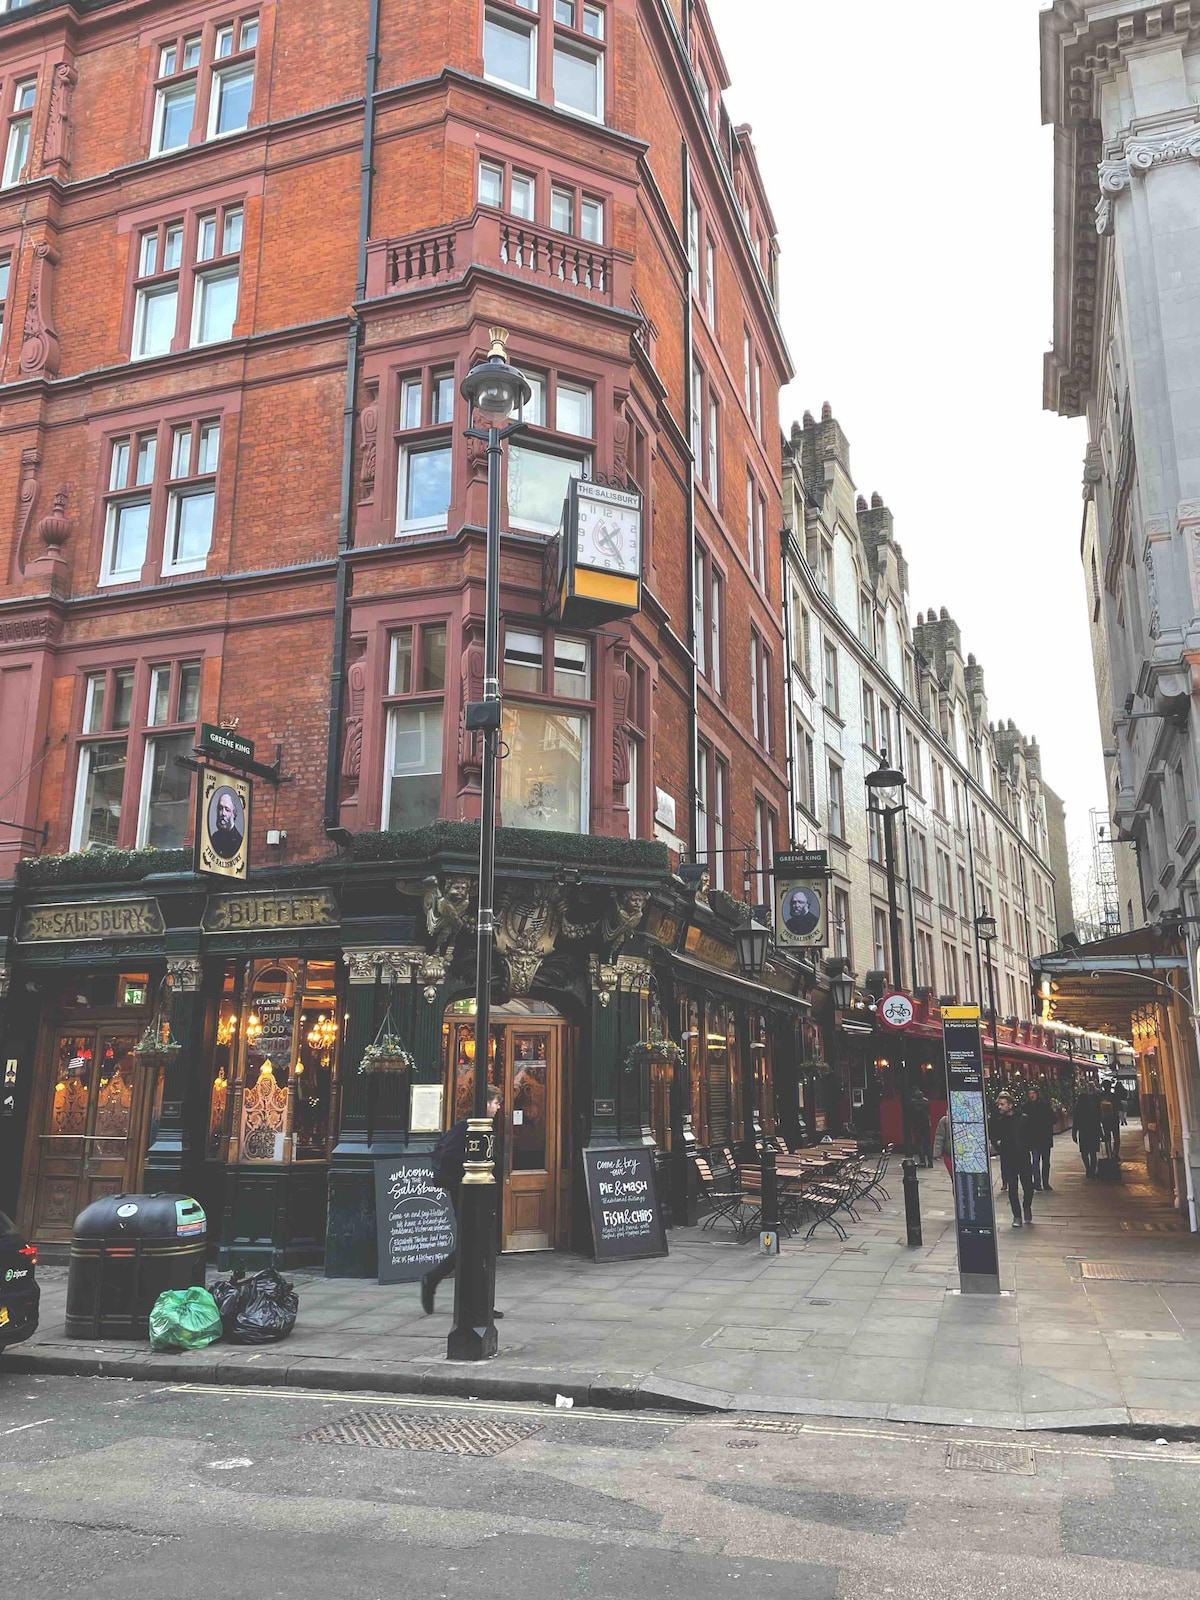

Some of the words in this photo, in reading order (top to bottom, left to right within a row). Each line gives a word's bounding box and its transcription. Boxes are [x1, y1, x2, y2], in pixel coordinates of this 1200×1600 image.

[578, 485, 595, 495] THE
[595, 489, 638, 505] SALISBURY
[603, 508, 613, 517] 12
[578, 528, 586, 536] 9
[630, 525, 637, 533] 2
[630, 540, 636, 548] 3
[589, 555, 596, 564] 7
[604, 559, 611, 568] 6
[210, 733, 234, 749] GREENE
[234, 742, 251, 755] KING
[205, 845, 215, 862] THE
[215, 853, 243, 868] SALISBURY
[229, 898, 320, 925] BUFFET
[35, 917, 53, 933] The
[53, 908, 145, 934] SALISBURY
[782, 929, 792, 939] THE
[793, 928, 820, 942] SALISBURY
[256, 997, 290, 1005] CLASSIC
[262, 1013, 281, 1023] PUB
[260, 1025, 285, 1034] OOD
[623, 1157, 641, 1175] try
[387, 1181, 447, 1200] Salisbury
[13, 1269, 28, 1279] zipcar
